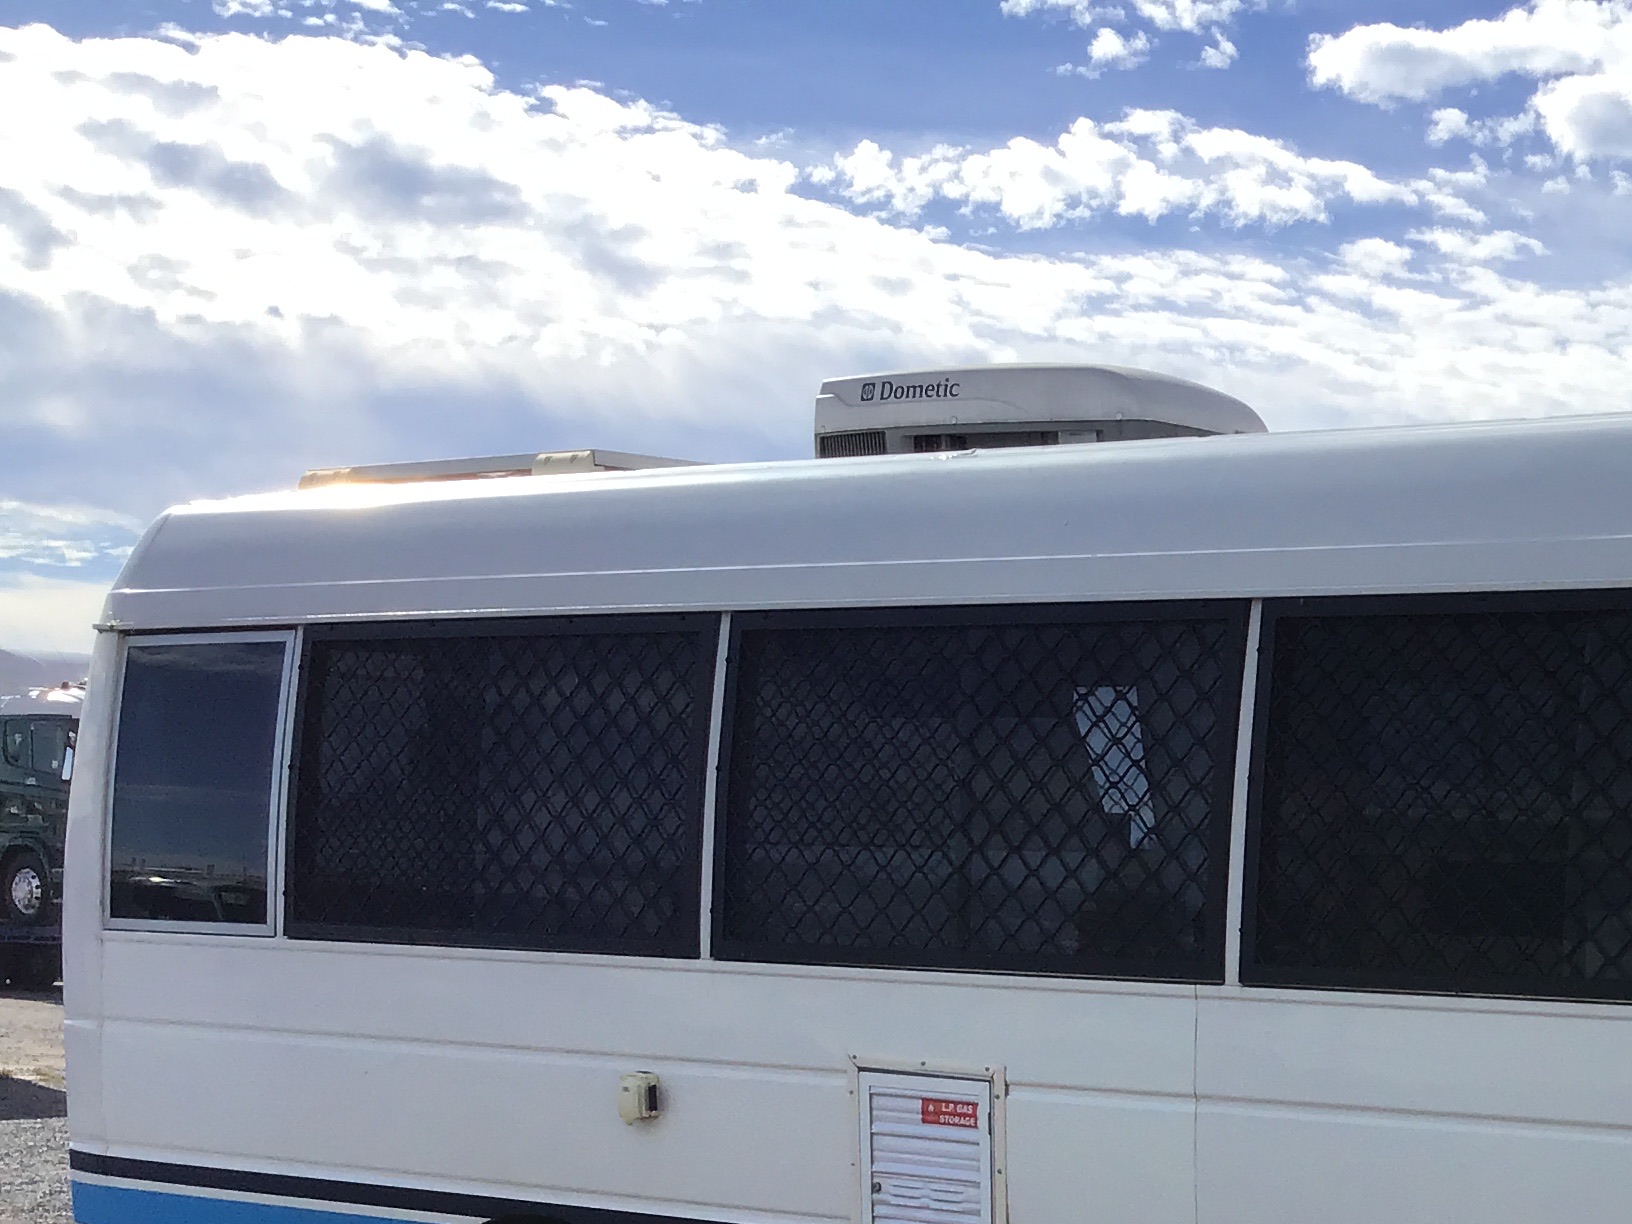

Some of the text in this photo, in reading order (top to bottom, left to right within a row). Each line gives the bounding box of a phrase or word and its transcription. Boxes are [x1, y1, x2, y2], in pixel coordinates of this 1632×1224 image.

[880, 378, 960, 401] Dometic
[956, 1103, 973, 1114] GAS
[939, 1114, 976, 1126] STORAGE
